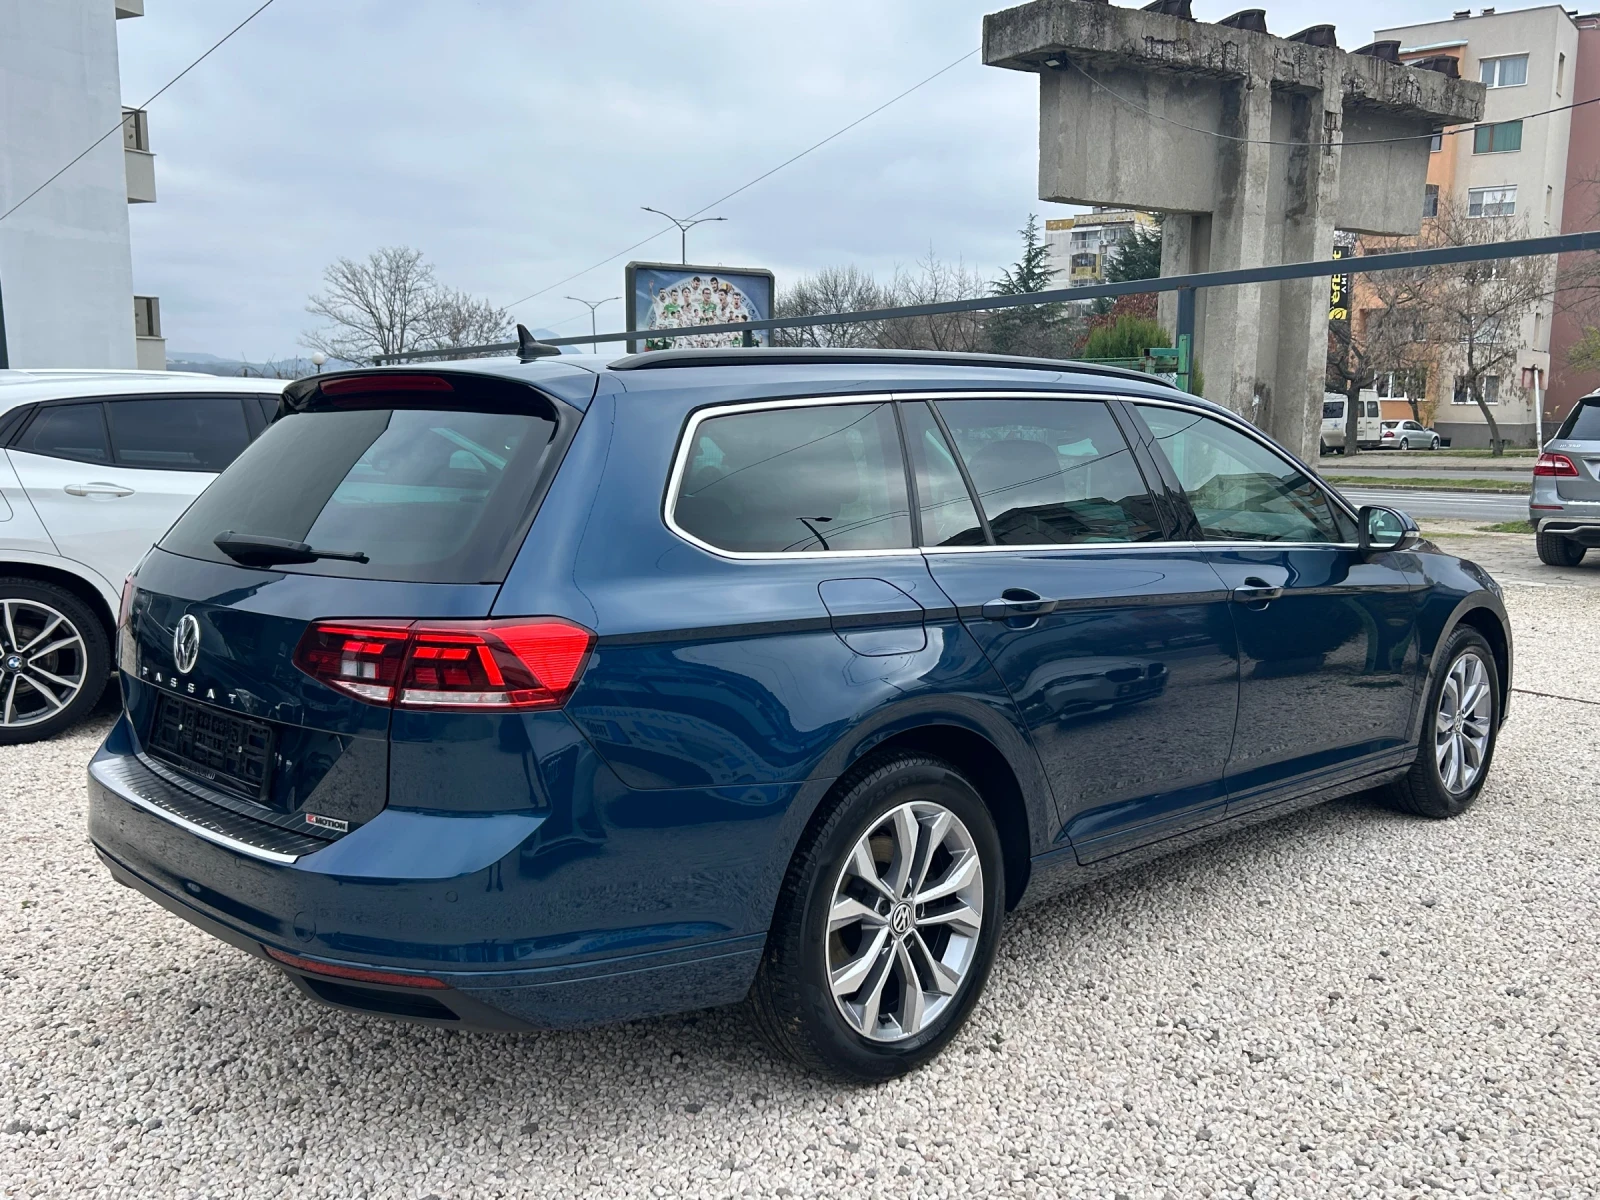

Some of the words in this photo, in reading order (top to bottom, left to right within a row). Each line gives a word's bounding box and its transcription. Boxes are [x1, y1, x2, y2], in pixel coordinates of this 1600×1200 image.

[1331, 250, 1341, 305] efbt
[142, 666, 237, 705] PASSAT
[307, 814, 347, 831] 4MOTION
